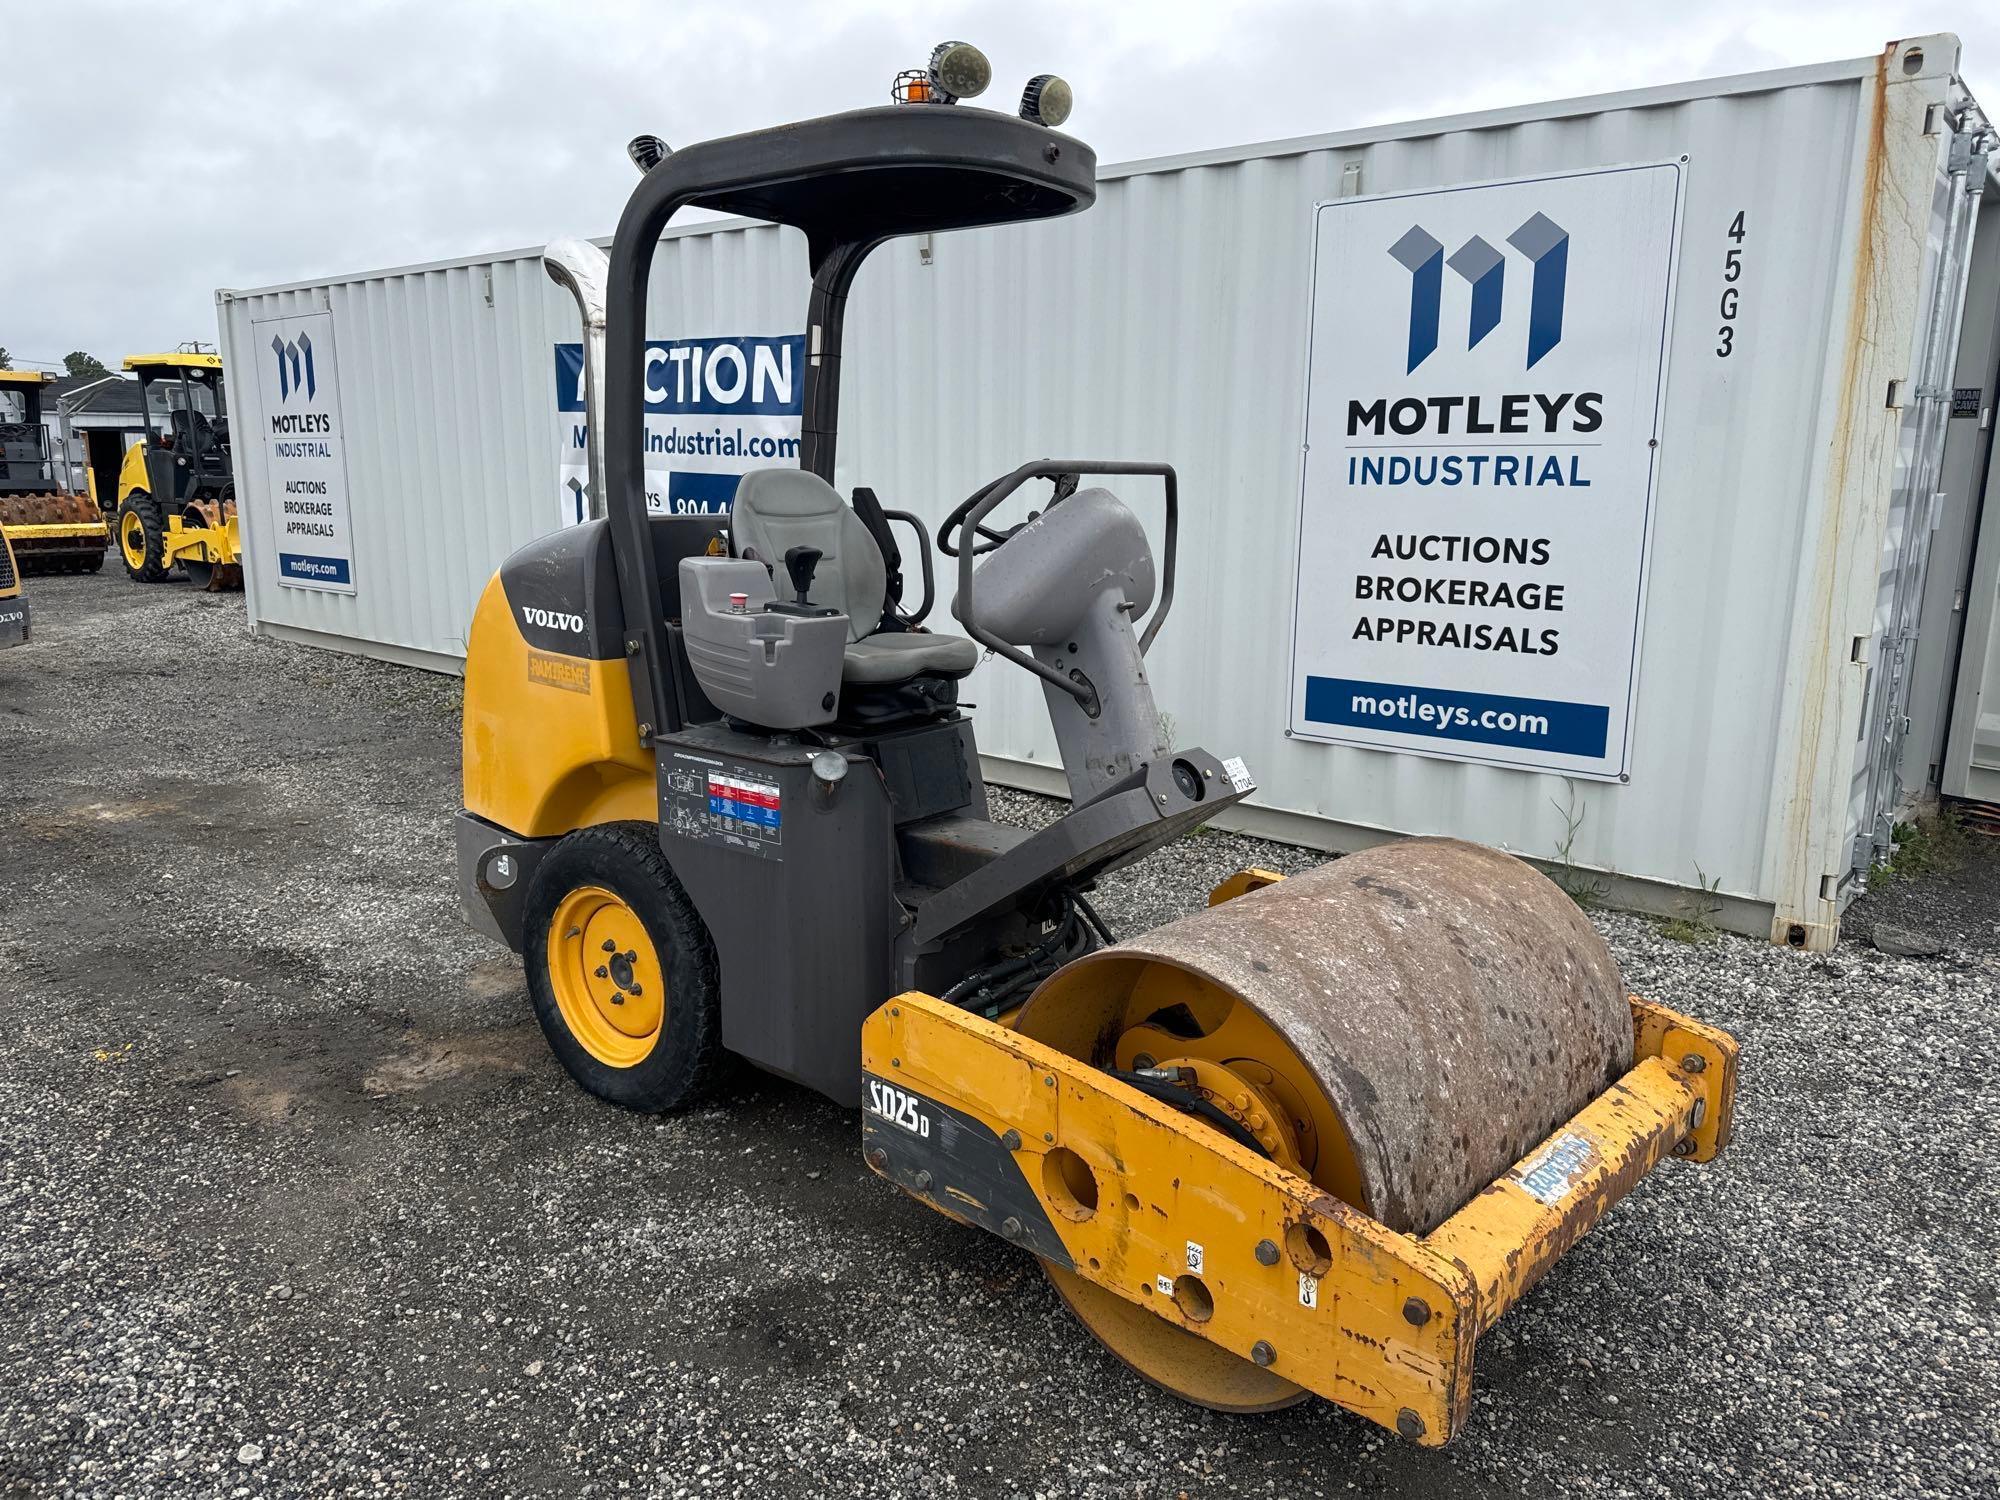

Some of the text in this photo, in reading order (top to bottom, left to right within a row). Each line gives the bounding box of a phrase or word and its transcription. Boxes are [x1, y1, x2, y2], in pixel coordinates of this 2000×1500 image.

[1716, 210, 1746, 358] 45G3
[576, 343, 792, 405] CTION
[1954, 400, 1979, 410] CAVE
[1955, 390, 1980, 400] MAN
[271, 413, 331, 434] MOTLEYS
[1347, 392, 1603, 437] MOTLEYS
[275, 442, 332, 458] INDUSTRIAL
[1348, 455, 1591, 487] INDUSTRIAL
[285, 480, 327, 495] AUCTIONS
[284, 500, 333, 516] BROKERAGE
[286, 521, 334, 538] APPRAISALS
[1371, 534, 1551, 566] AUCTIONS
[290, 558, 338, 576] motleys.com
[1355, 575, 1565, 612] BROKERAGE
[522, 606, 584, 633] VOLVO
[1352, 616, 1560, 656] APPRAISALS
[1351, 693, 1549, 736] motleys.com
